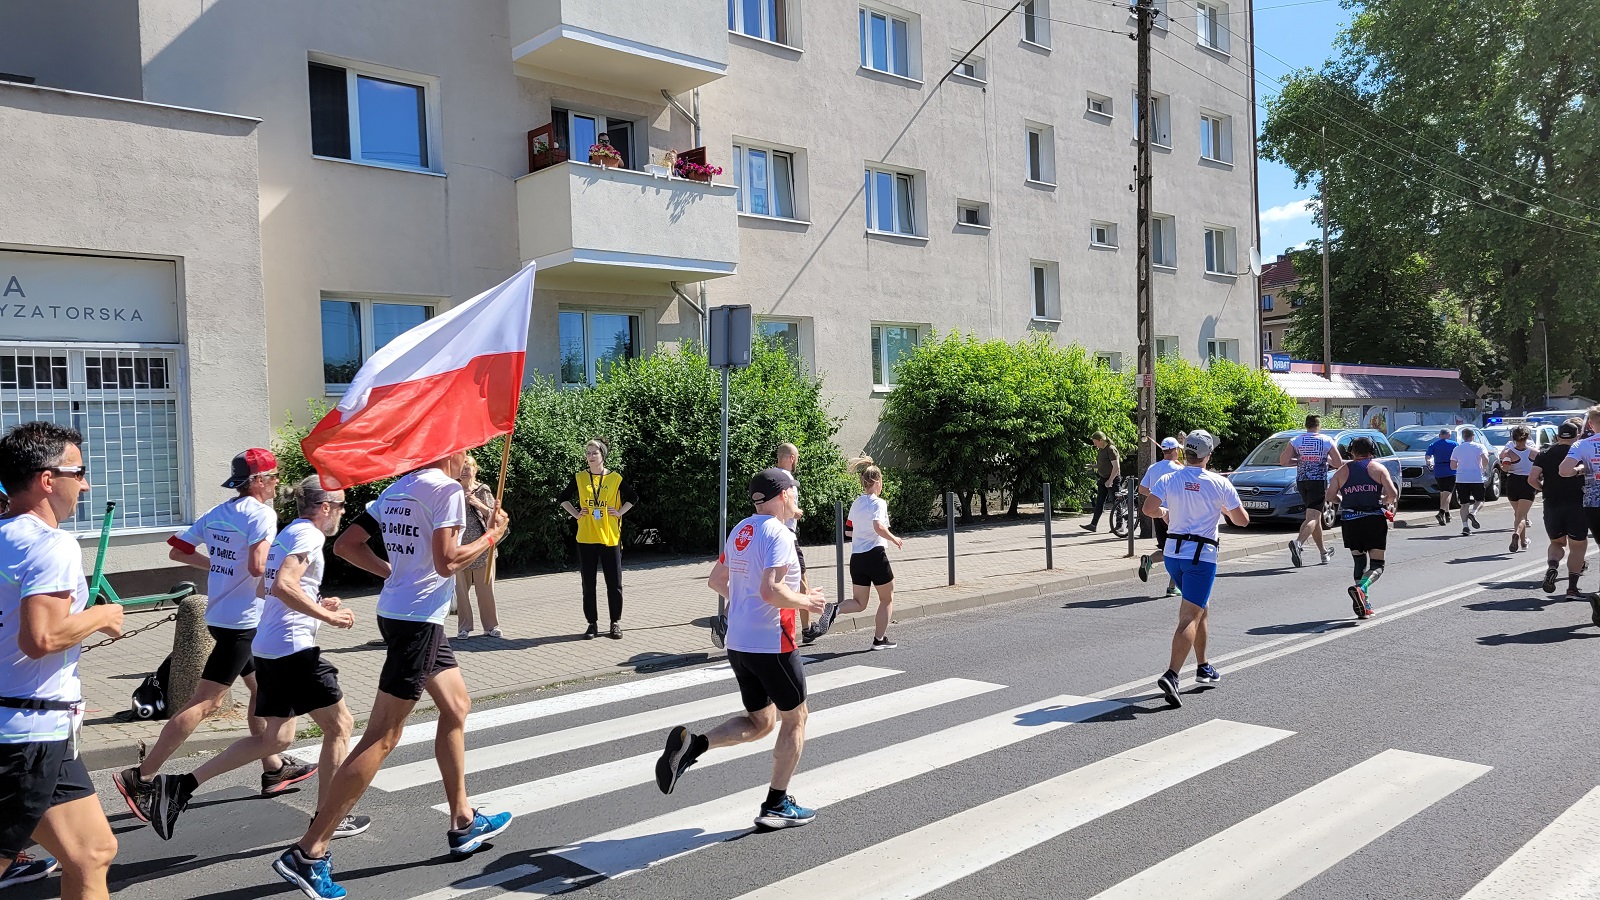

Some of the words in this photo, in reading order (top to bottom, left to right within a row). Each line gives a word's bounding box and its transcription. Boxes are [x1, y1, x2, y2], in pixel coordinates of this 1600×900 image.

[3, 275, 26, 298] A
[0, 303, 143, 322] YZATORSKA
[1344, 484, 1378, 494] MARCIN
[384, 506, 412, 517] JAKUB
[386, 543, 415, 555] OZNAŃ
[210, 564, 234, 577] OZNAŃ
